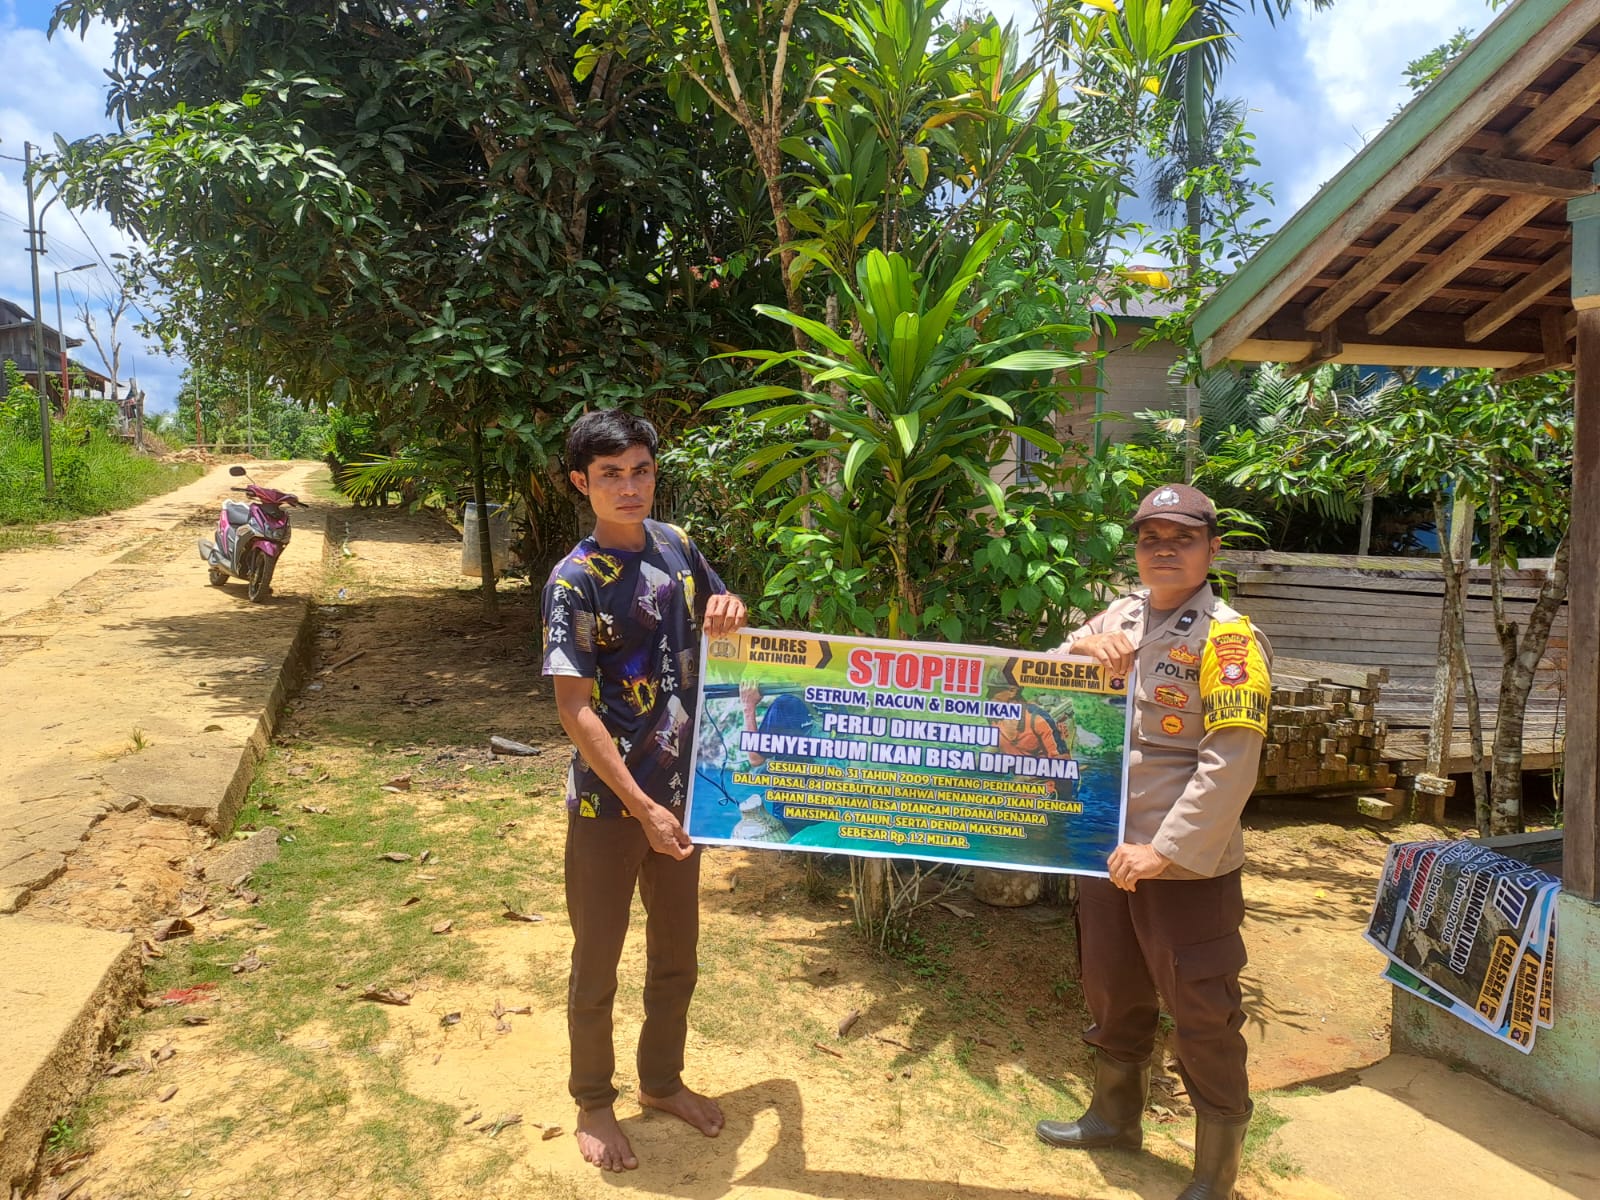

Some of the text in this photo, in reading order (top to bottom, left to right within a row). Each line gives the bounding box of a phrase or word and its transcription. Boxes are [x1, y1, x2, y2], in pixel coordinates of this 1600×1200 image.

[749, 653, 806, 665] KATINGAN
[751, 636, 807, 653] POLRES
[850, 650, 981, 693] STOP!!!
[1022, 660, 1099, 680] POLSEK
[807, 688, 1021, 719] SETRUM, RACUN & BOM IKAN
[824, 714, 999, 746] PERLU DIKETAHUI
[741, 733, 1078, 780] MENYETRUM IKAN BISA DIPIDANA
[733, 774, 1081, 813] DALAM PASAL 84 DISEBUTKAN BAHWA MENANGKAP IKAN DENGAN
[769, 762, 1048, 797] SESUAI UU No. 31 TAHUN 2009 TENTANG PERIKANAN,
[766, 791, 1047, 825] BAHAN BERBAHAYA BISA DIANCAM PIDANA PENJARA
[785, 808, 1026, 838] MAKSIMAL 6 TAHUN, SERTA DENDA MAKSIMAL
[840, 827, 887, 840] SEBESAR
[890, 832, 908, 844] Rp.
[927, 834, 969, 848] MILIAR.
[1427, 877, 1441, 901] Batu
[1450, 878, 1468, 913] Tahun
[1420, 904, 1432, 927] Bara
[1442, 914, 1457, 942] 2009
[1490, 943, 1516, 1002] POLSEK
[1521, 962, 1538, 1026] POLSEK
